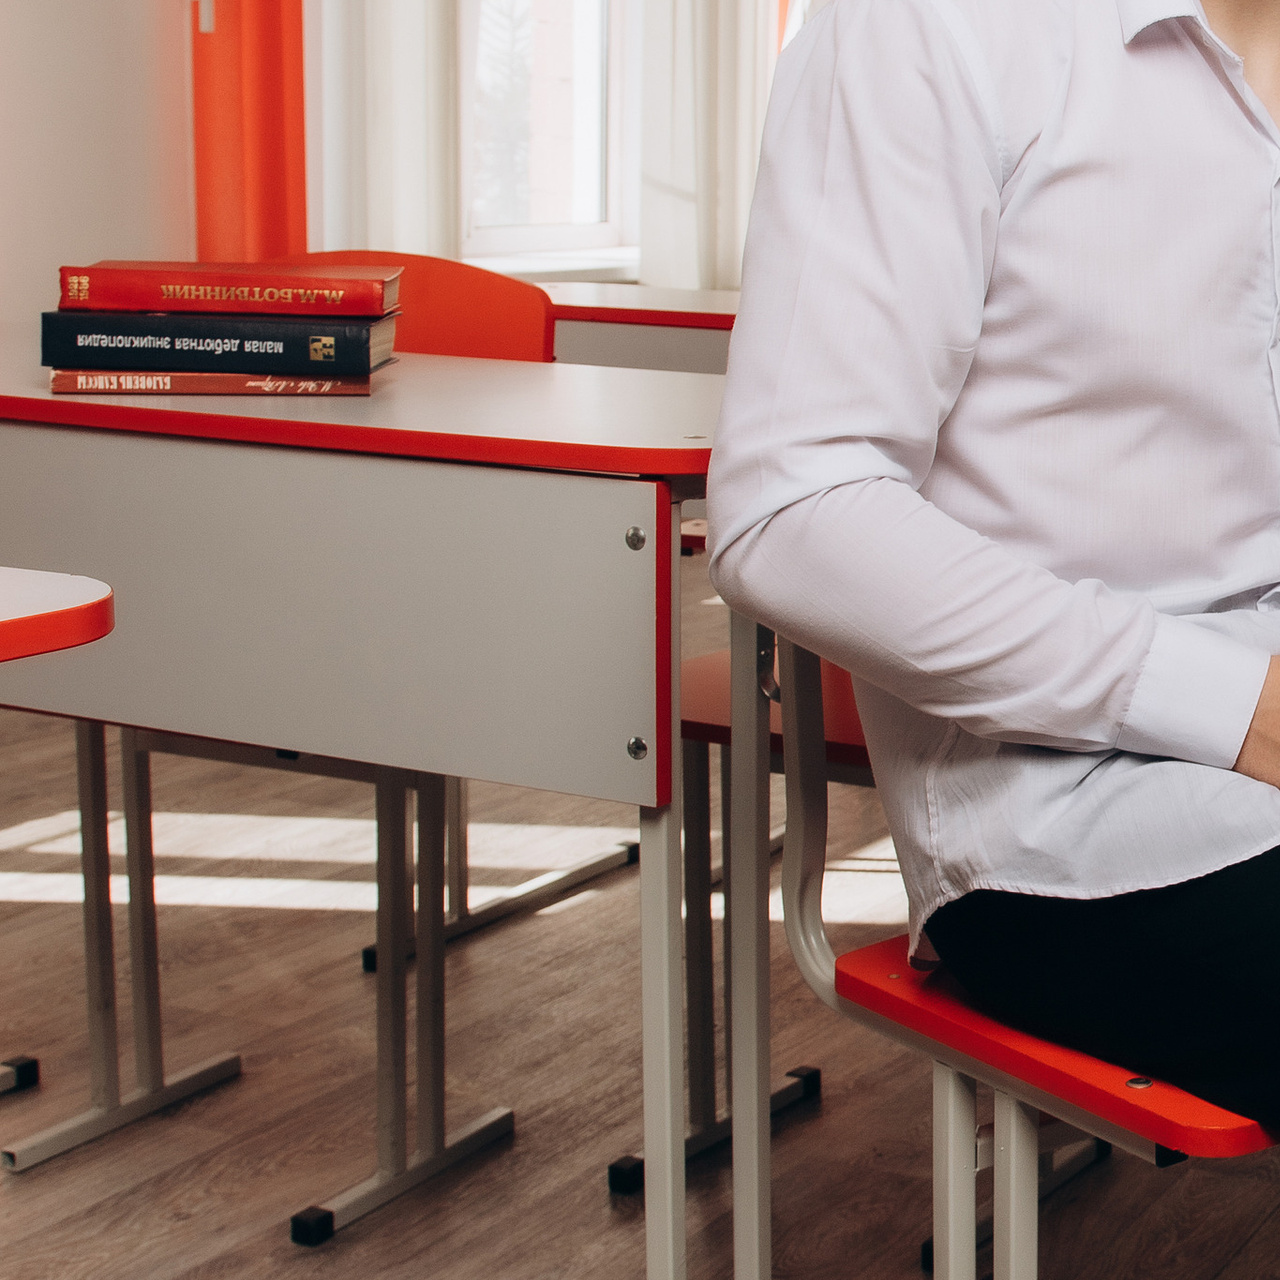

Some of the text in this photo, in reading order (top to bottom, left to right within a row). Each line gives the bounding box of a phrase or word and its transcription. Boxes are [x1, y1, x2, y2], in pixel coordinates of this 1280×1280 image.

[161, 285, 345, 304] М.М.БОТВИННИК
[77, 334, 283, 354] малая дебютная энциклопедия
